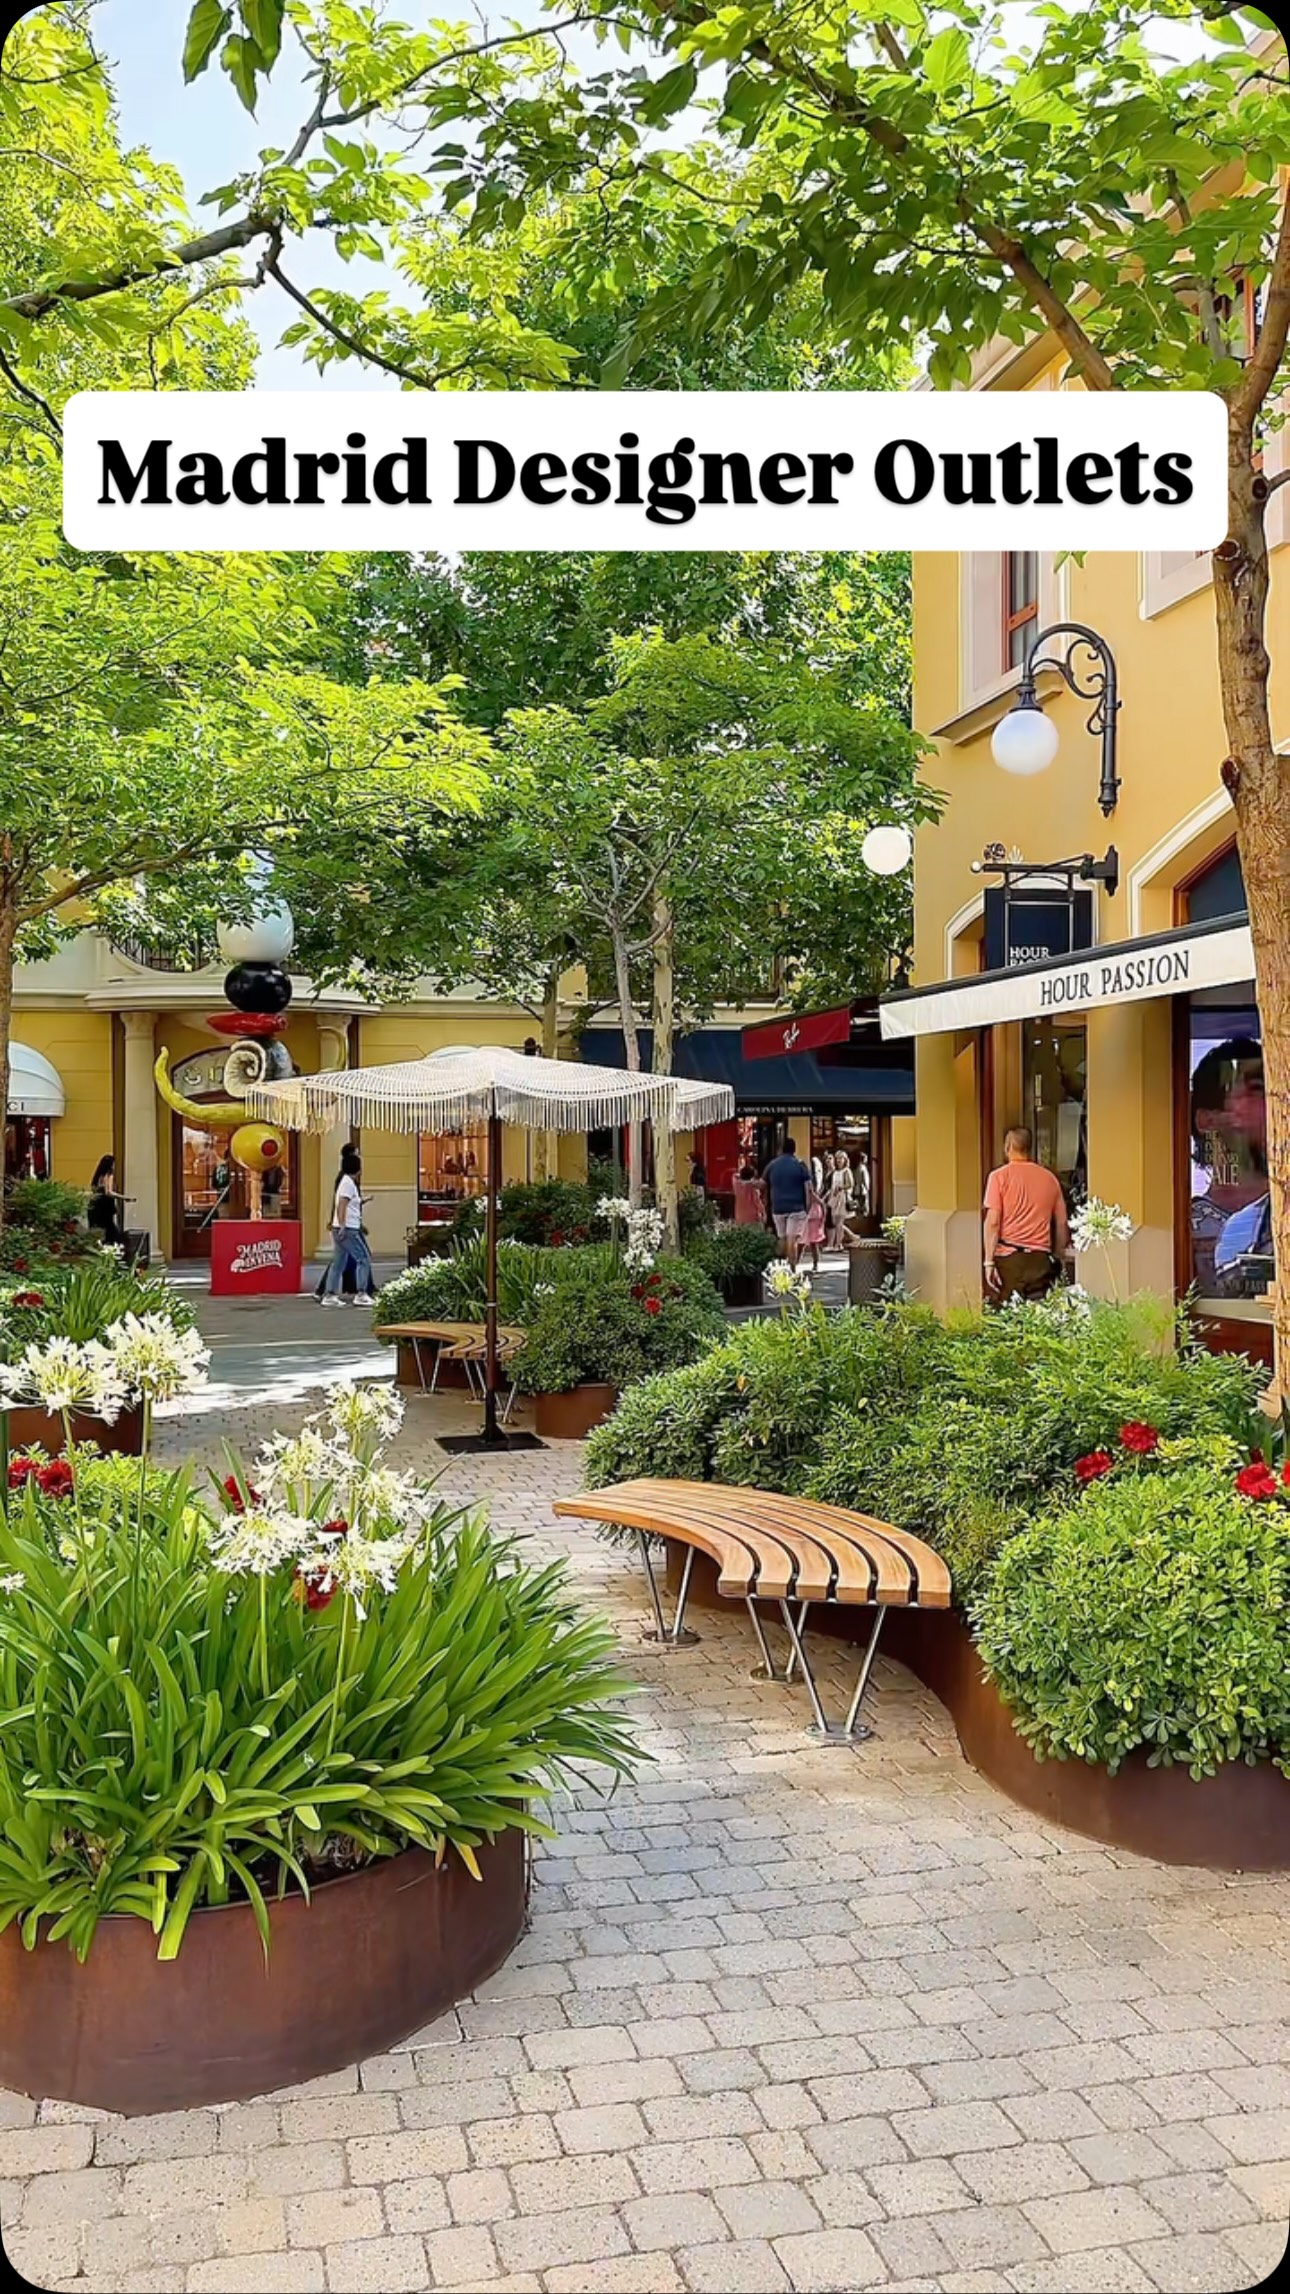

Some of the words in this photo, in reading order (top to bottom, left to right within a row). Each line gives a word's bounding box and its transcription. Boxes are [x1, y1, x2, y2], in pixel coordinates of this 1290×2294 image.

[1009, 946, 1050, 959] HOUR
[1040, 972, 1092, 1006] HOUR
[1101, 950, 1190, 996] PASSION
[236, 1239, 282, 1259] MADRID
